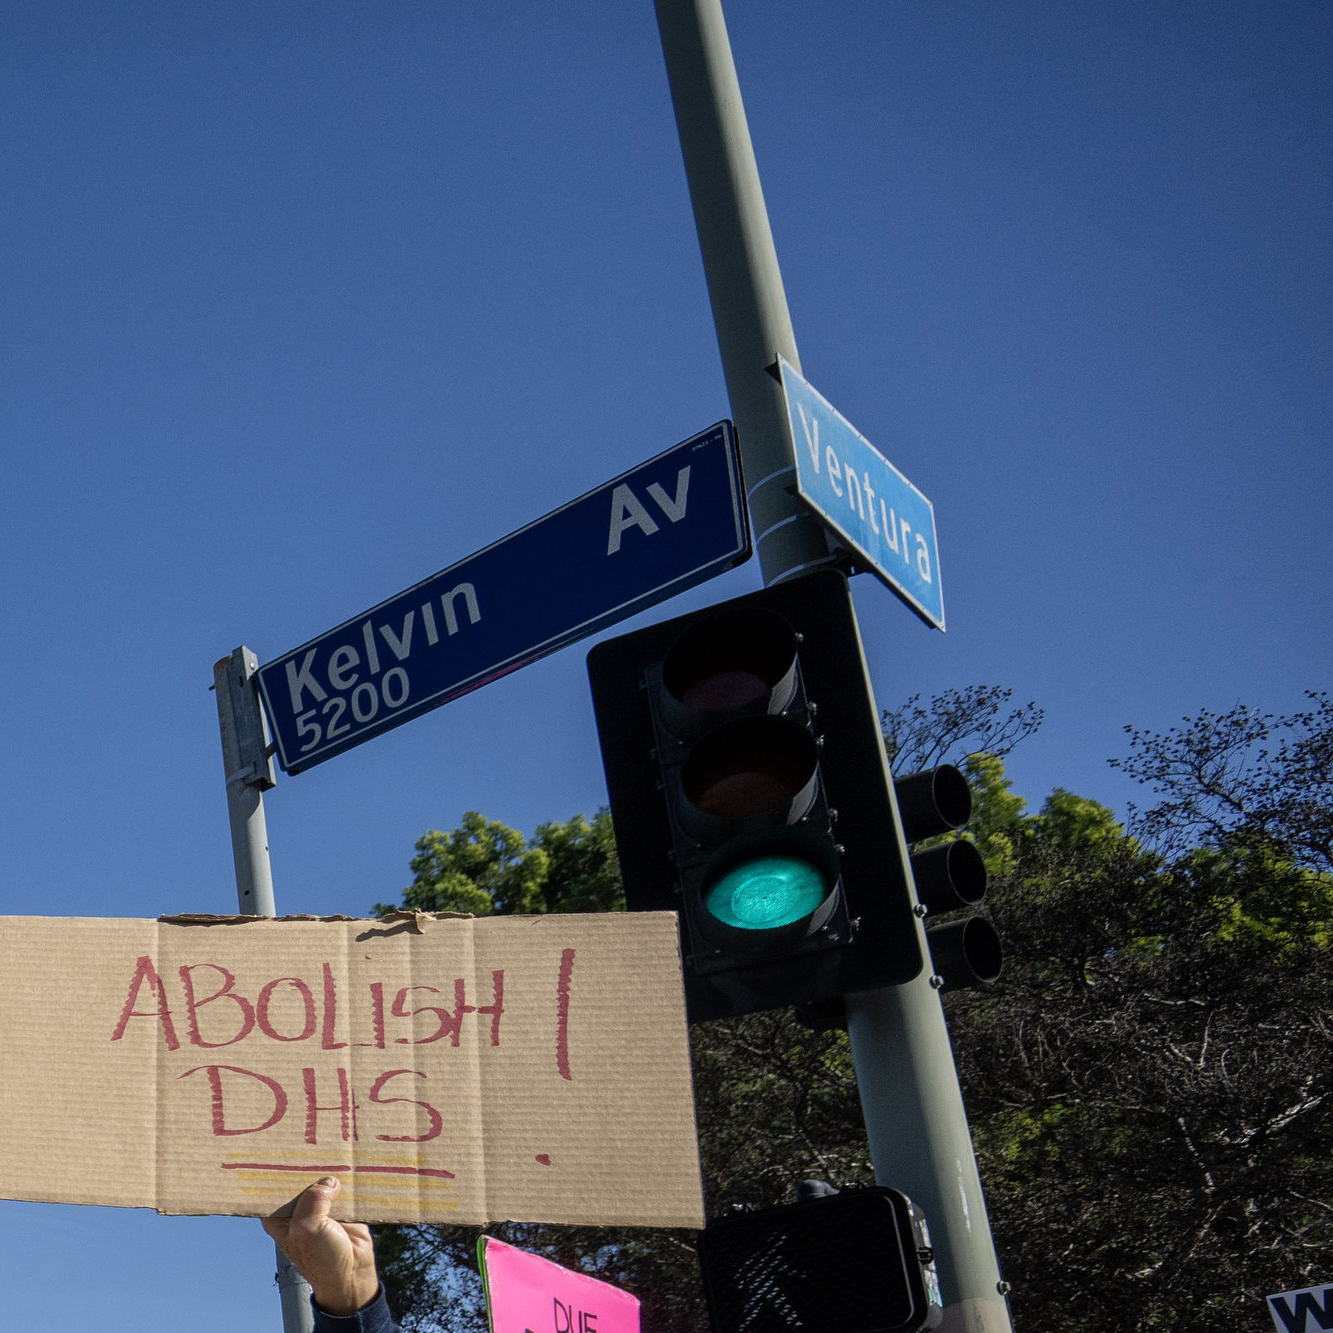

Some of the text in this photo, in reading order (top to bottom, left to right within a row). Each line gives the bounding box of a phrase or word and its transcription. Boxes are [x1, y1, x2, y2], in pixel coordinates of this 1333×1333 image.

[796, 402, 932, 585] Ventura
[285, 465, 691, 715] Kelvin Av
[295, 666, 411, 753] 5200
[178, 1064, 444, 1145] DHS
